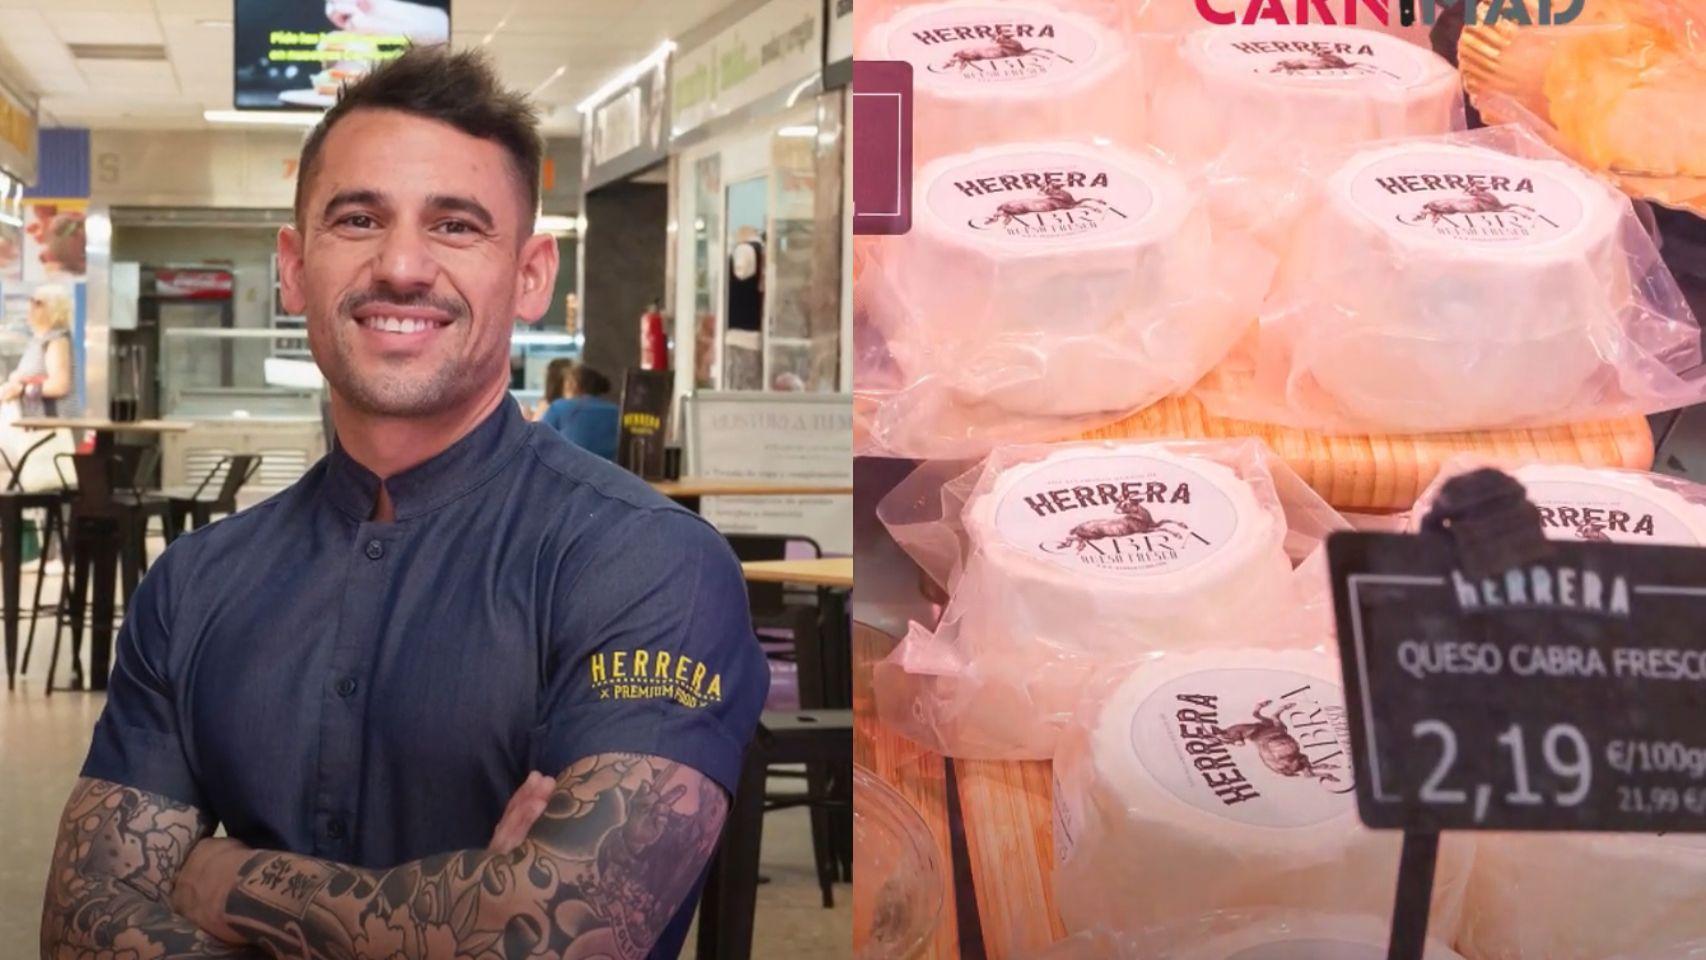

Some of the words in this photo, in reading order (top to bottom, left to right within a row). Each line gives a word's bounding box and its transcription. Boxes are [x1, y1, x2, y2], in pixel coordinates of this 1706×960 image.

[912, 24, 1055, 45] HERRERA
[1231, 41, 1375, 57] HERRERA
[953, 171, 1109, 197] HERRERA
[1375, 174, 1535, 195] HERRERA
[1024, 481, 1191, 517] HERRERA
[1536, 505, 1655, 537] RRERA
[591, 650, 722, 696] HERRERA
[1397, 641, 1501, 678] QUESO
[1509, 644, 1605, 679] CABRA
[1612, 648, 1706, 681] FRESC
[614, 684, 674, 700] PREMIUM
[1176, 693, 1260, 806] HERRERA
[1412, 718, 1593, 824] 2,19
[1616, 786, 1680, 815] 21,99
